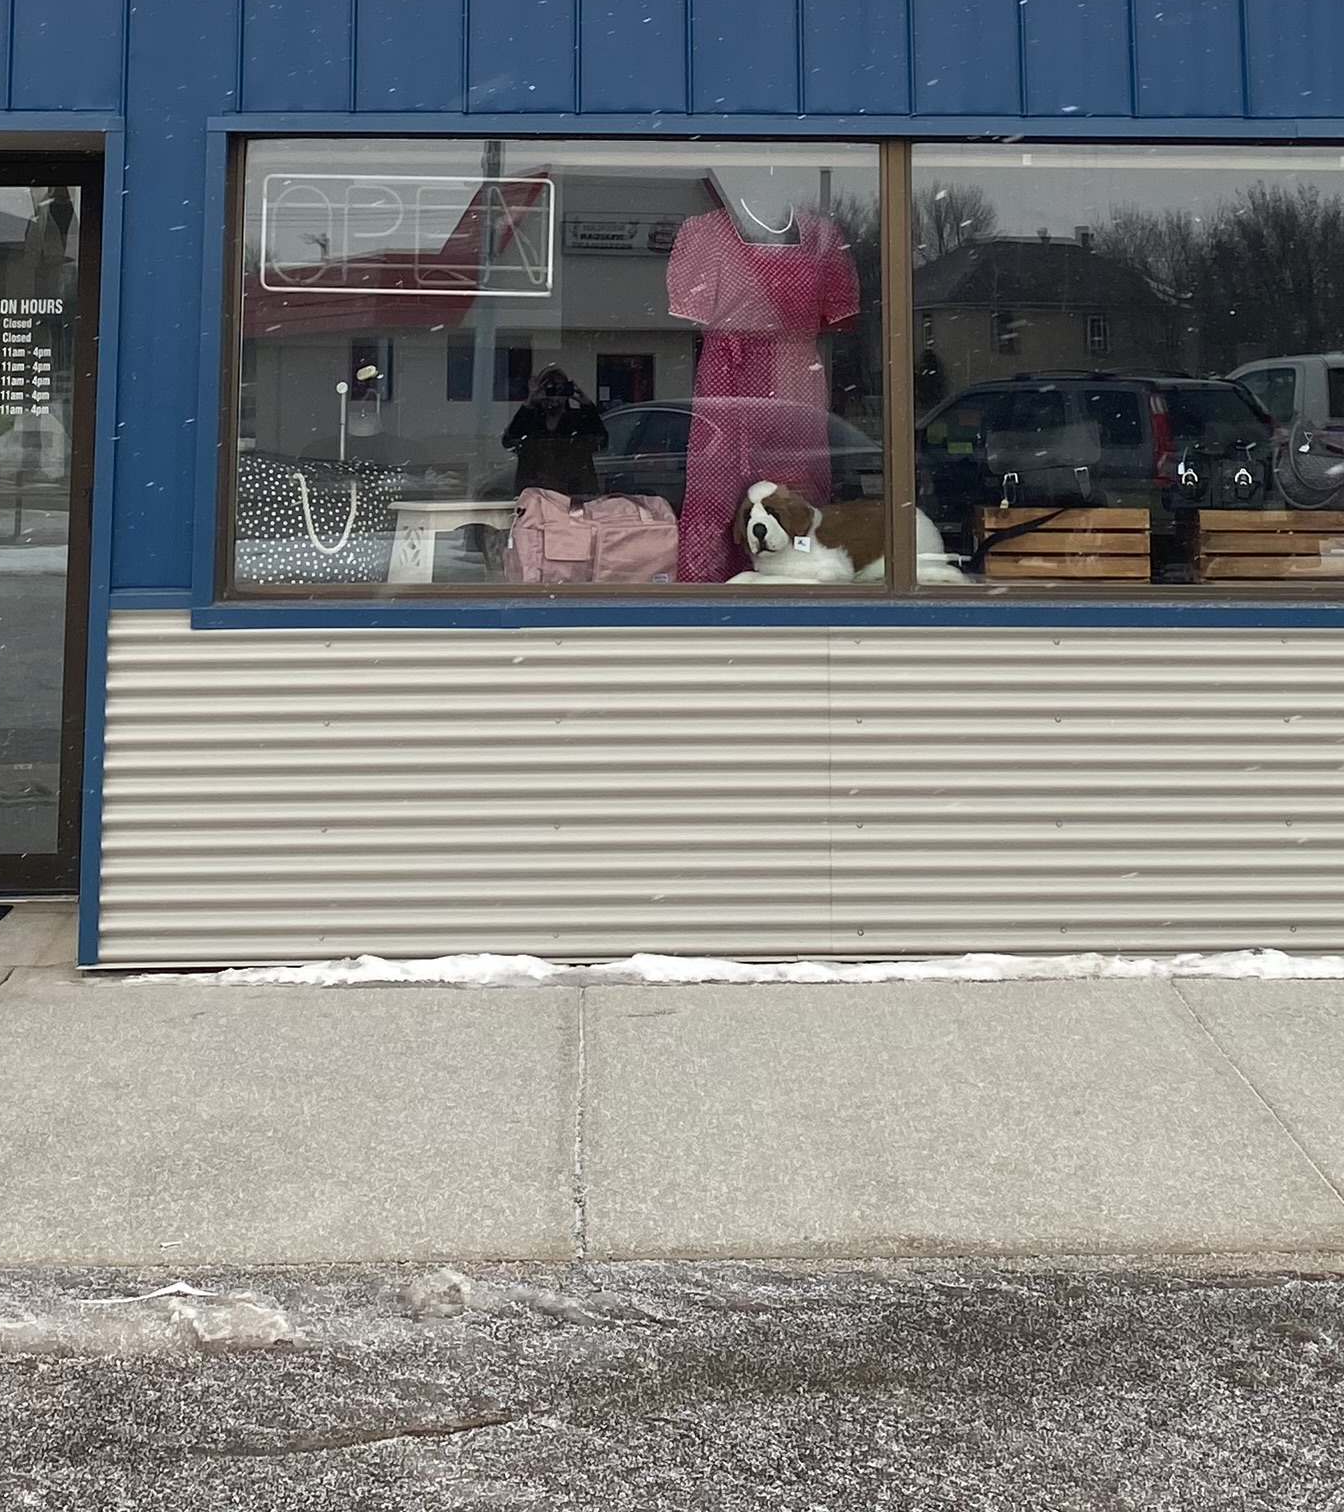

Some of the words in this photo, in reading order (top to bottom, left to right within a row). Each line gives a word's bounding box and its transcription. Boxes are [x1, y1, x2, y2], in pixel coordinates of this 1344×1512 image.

[271, 185, 549, 286] OPEN
[20, 299, 63, 314] HOURS
[3, 318, 32, 328] Closed
[2, 333, 32, 343] Closed
[2, 347, 25, 357] 11am
[33, 347, 51, 359] 4pm
[2, 362, 24, 371] 11am
[33, 362, 50, 373] 4pm
[1, 376, 24, 386] 11am
[32, 376, 50, 387] 4pm
[0, 391, 23, 400] 11am
[31, 391, 50, 402] 4pm
[0, 405, 23, 415] 11am
[31, 405, 49, 416] 4pm
